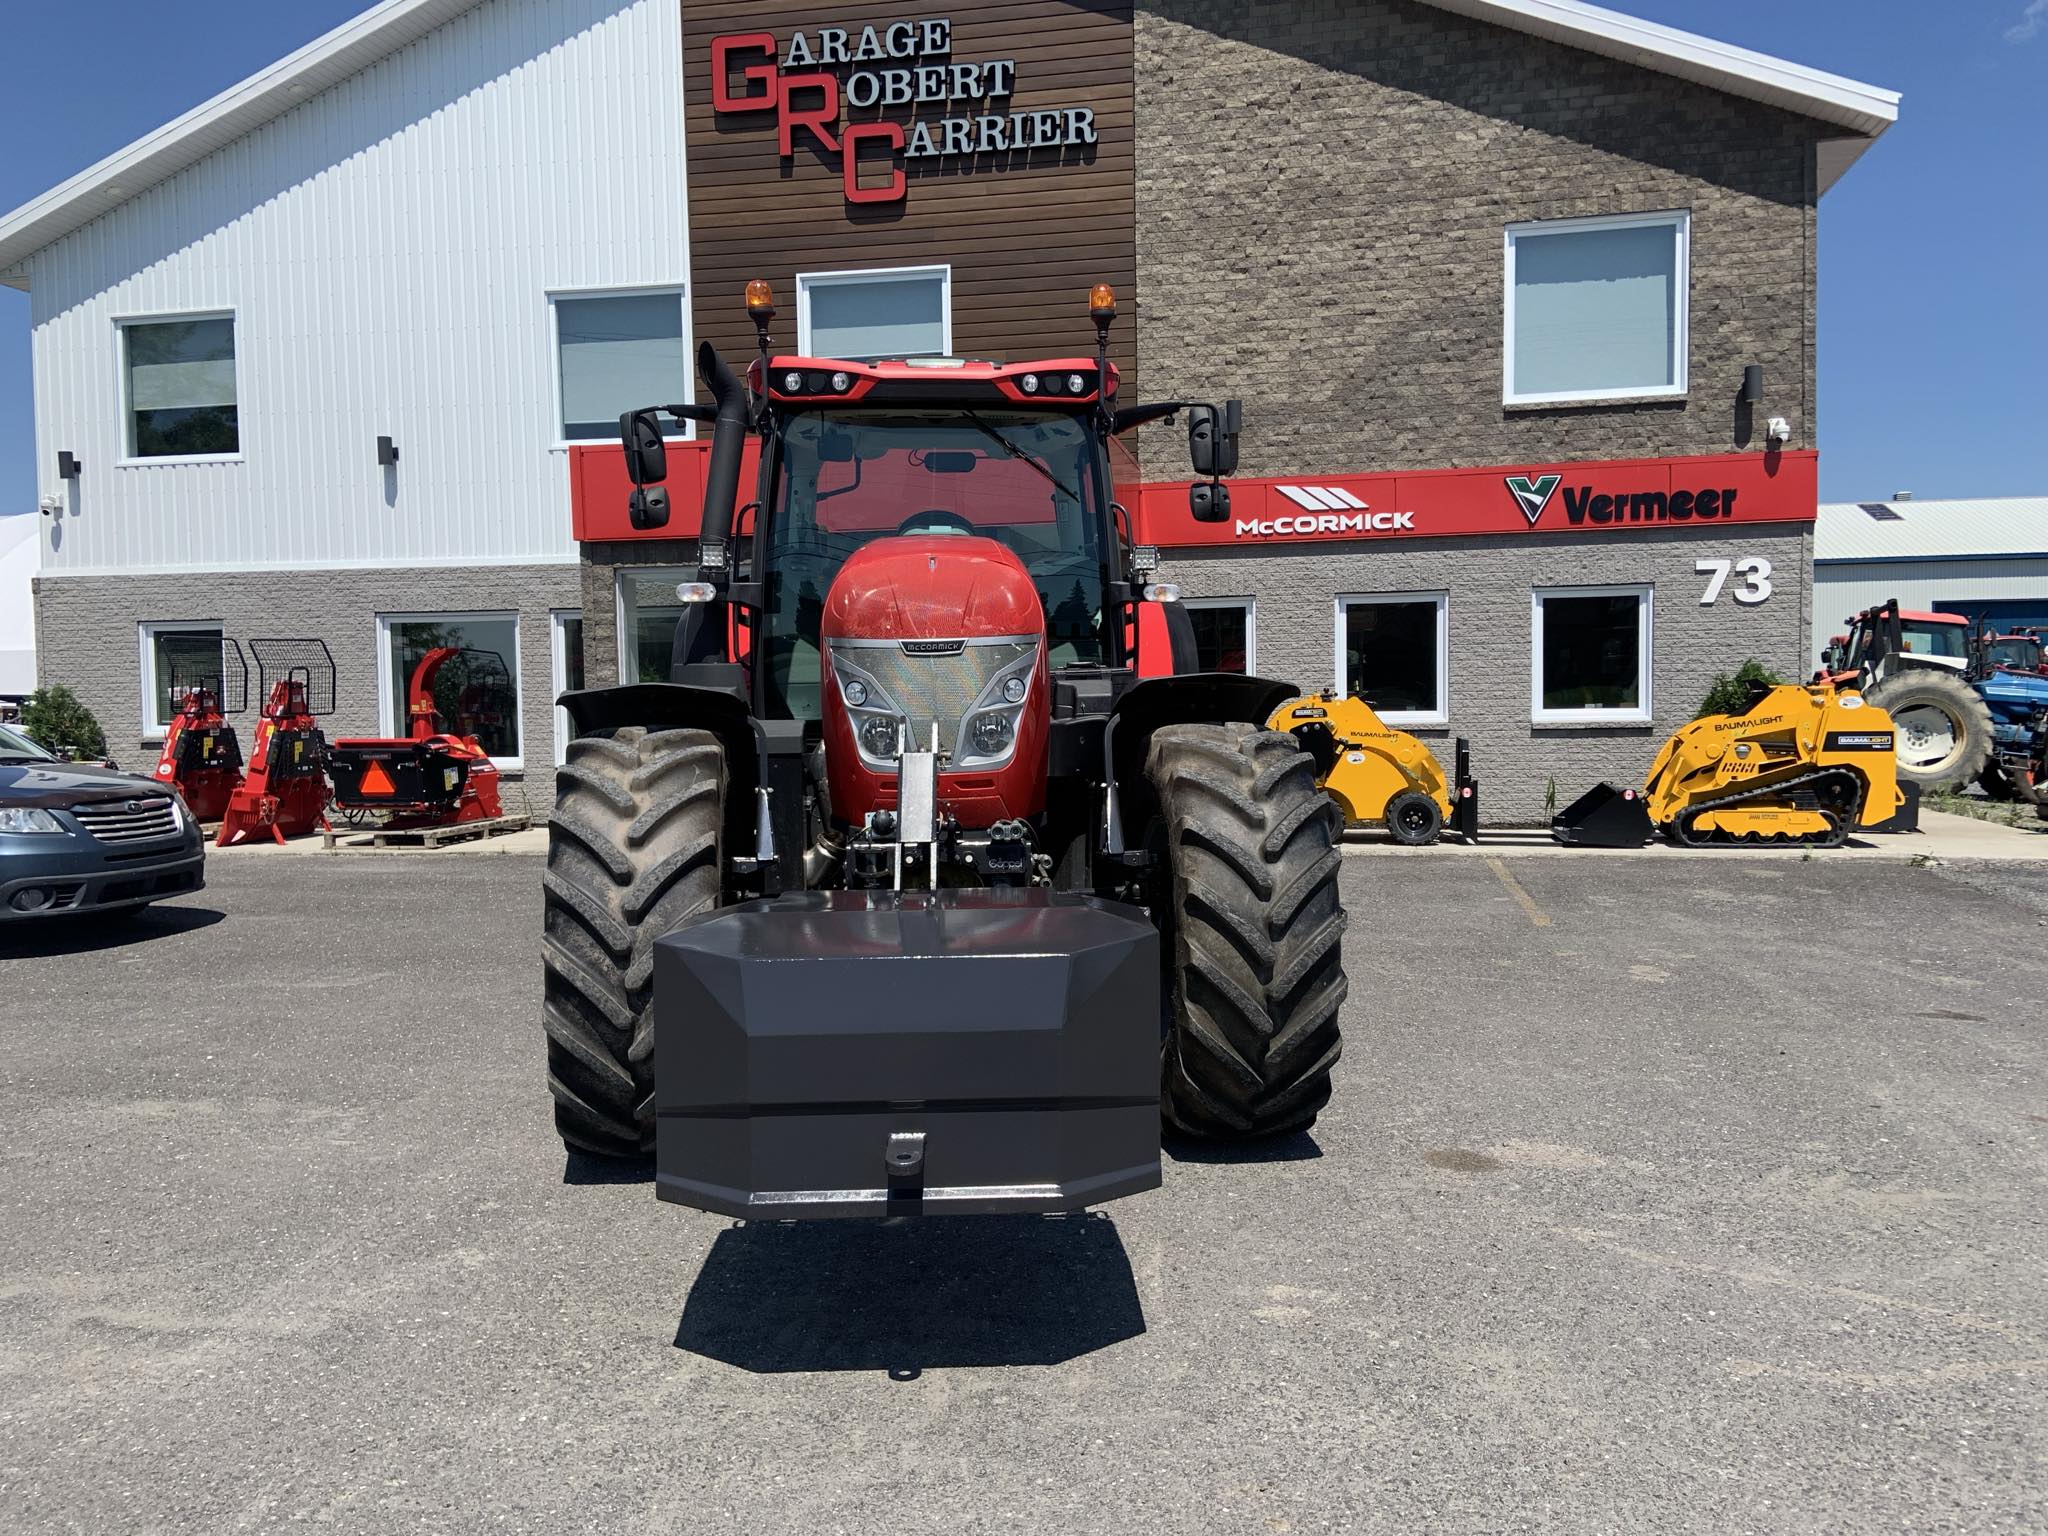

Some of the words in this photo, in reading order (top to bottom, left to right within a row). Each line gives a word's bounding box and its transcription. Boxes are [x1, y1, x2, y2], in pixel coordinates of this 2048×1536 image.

[1562, 485, 1738, 526] Vermeer
[1235, 511, 1415, 536] McCORMICK
[1695, 557, 1773, 604] 73
[1714, 715, 1784, 732] BAUMALIGHT
